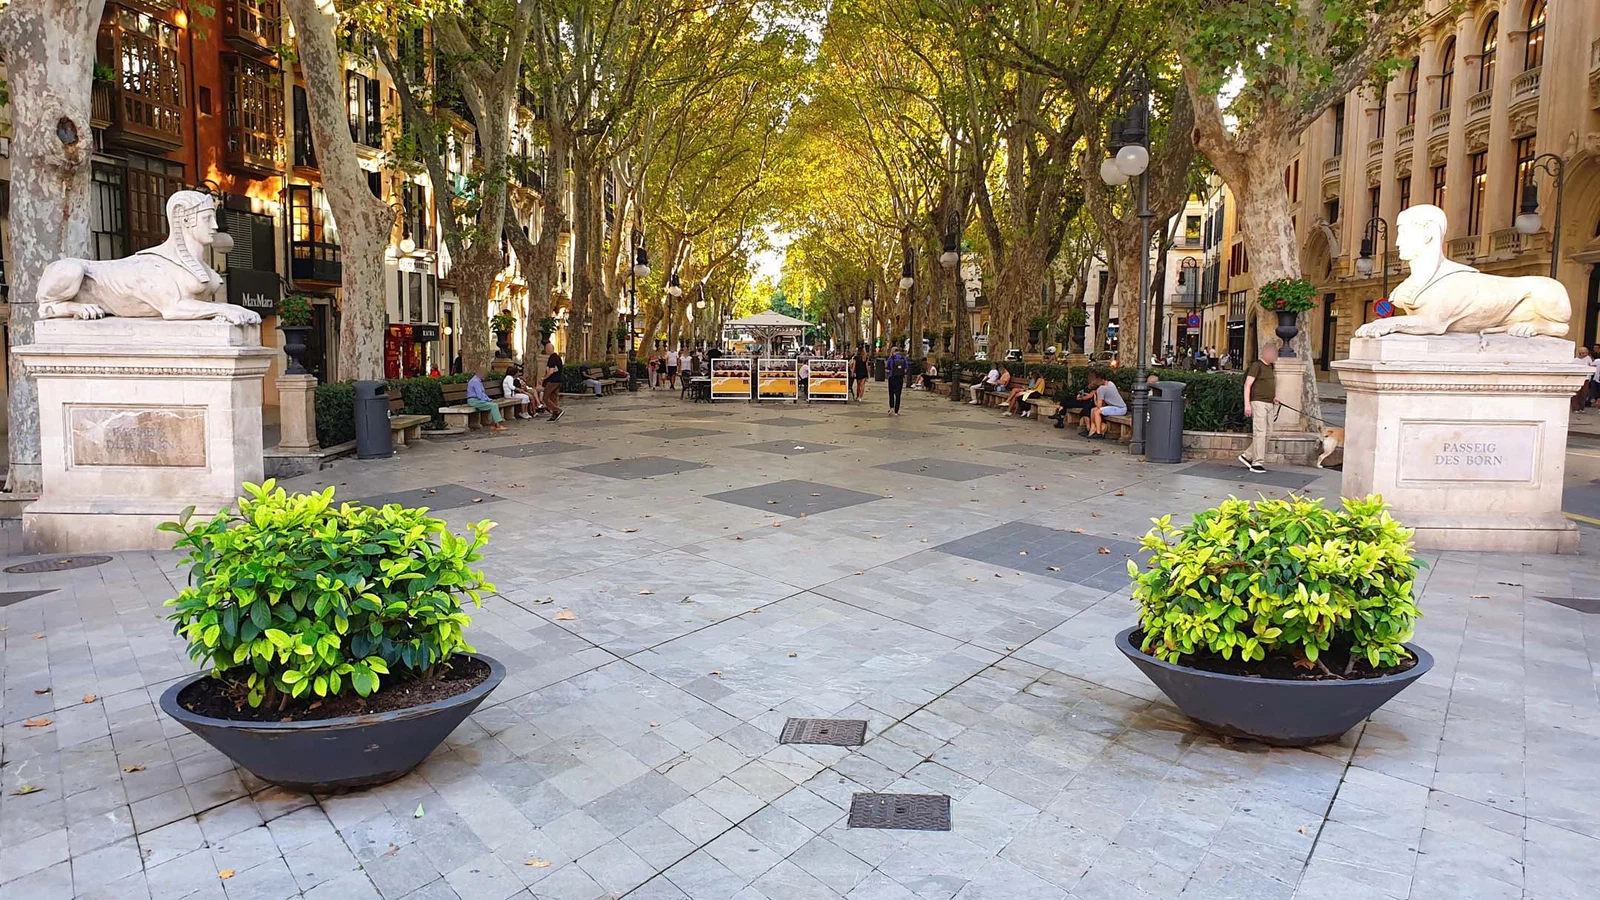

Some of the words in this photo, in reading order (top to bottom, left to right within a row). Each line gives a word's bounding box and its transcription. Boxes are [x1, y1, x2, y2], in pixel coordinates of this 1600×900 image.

[242, 292, 274, 308] MaxMara
[1442, 442, 1497, 453] PASSEIG
[1435, 455, 1460, 466] DES
[1466, 455, 1503, 466] BORN
